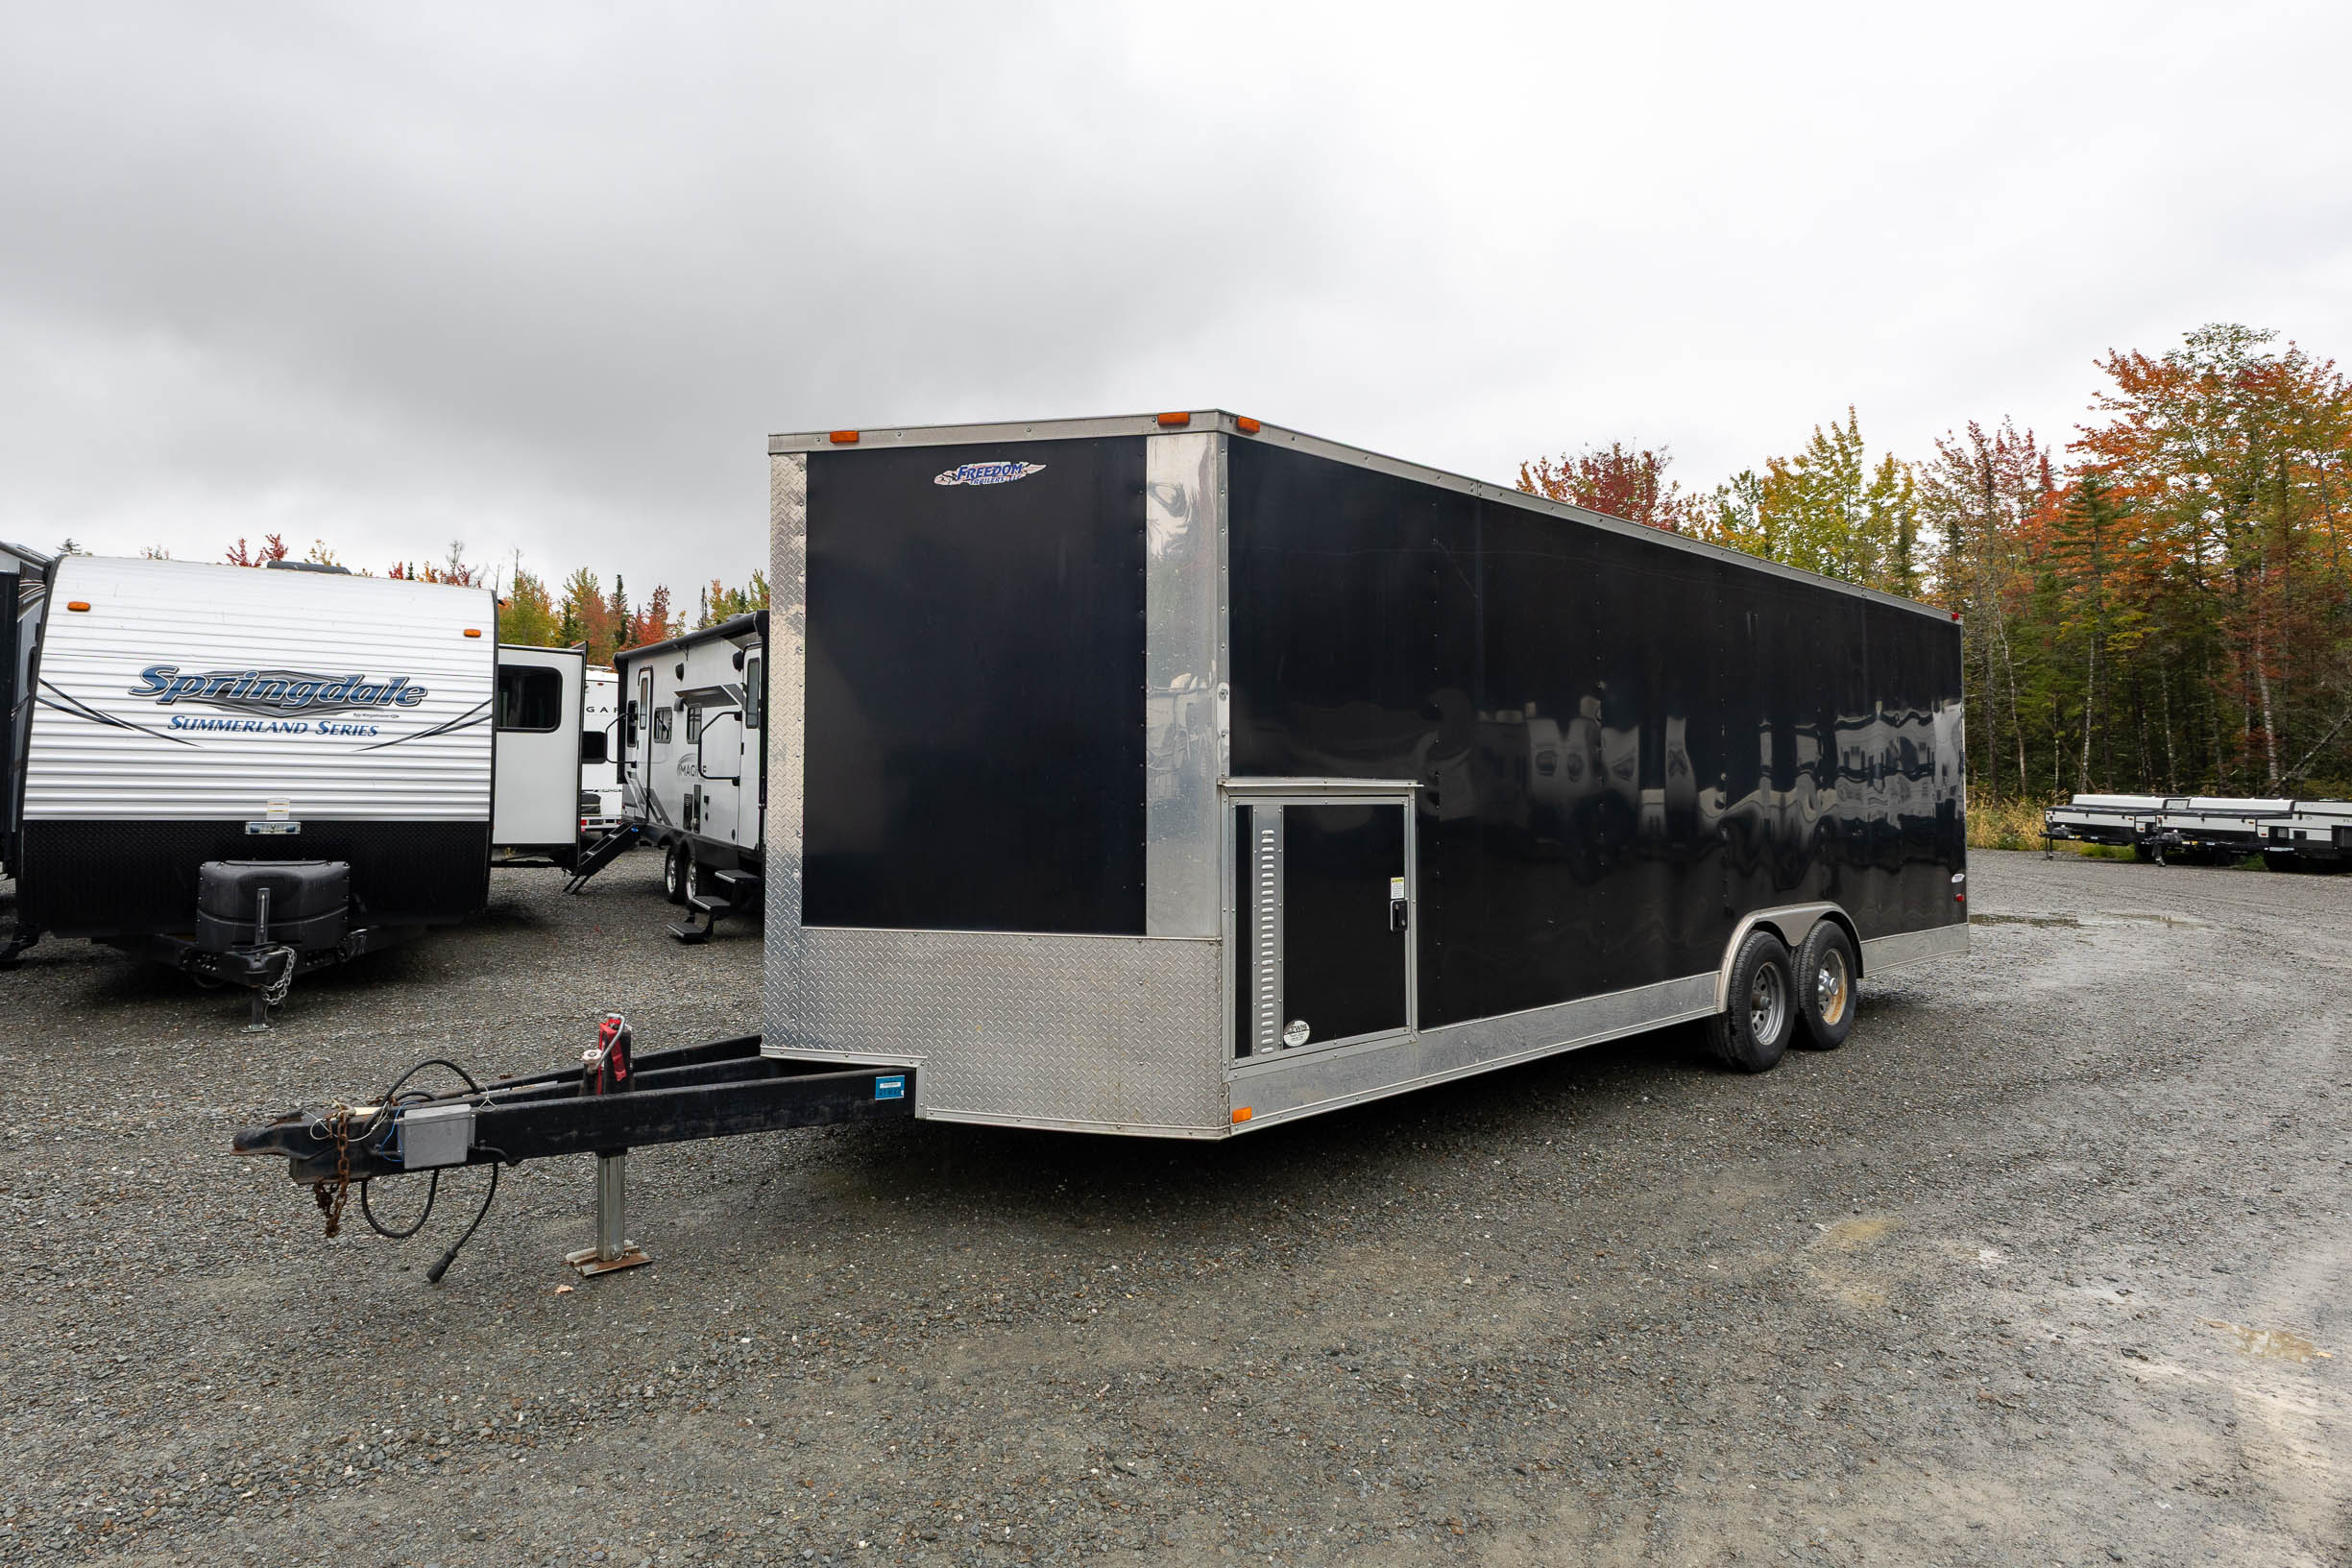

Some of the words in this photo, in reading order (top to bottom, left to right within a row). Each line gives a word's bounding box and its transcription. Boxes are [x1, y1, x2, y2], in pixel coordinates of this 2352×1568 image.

[957, 464, 1023, 480] FREEDOM
[129, 664, 429, 708] Springdale
[167, 714, 308, 736] SUMMERLAND
[315, 720, 379, 736] SERIES
[677, 764, 707, 777] IMAGIE
